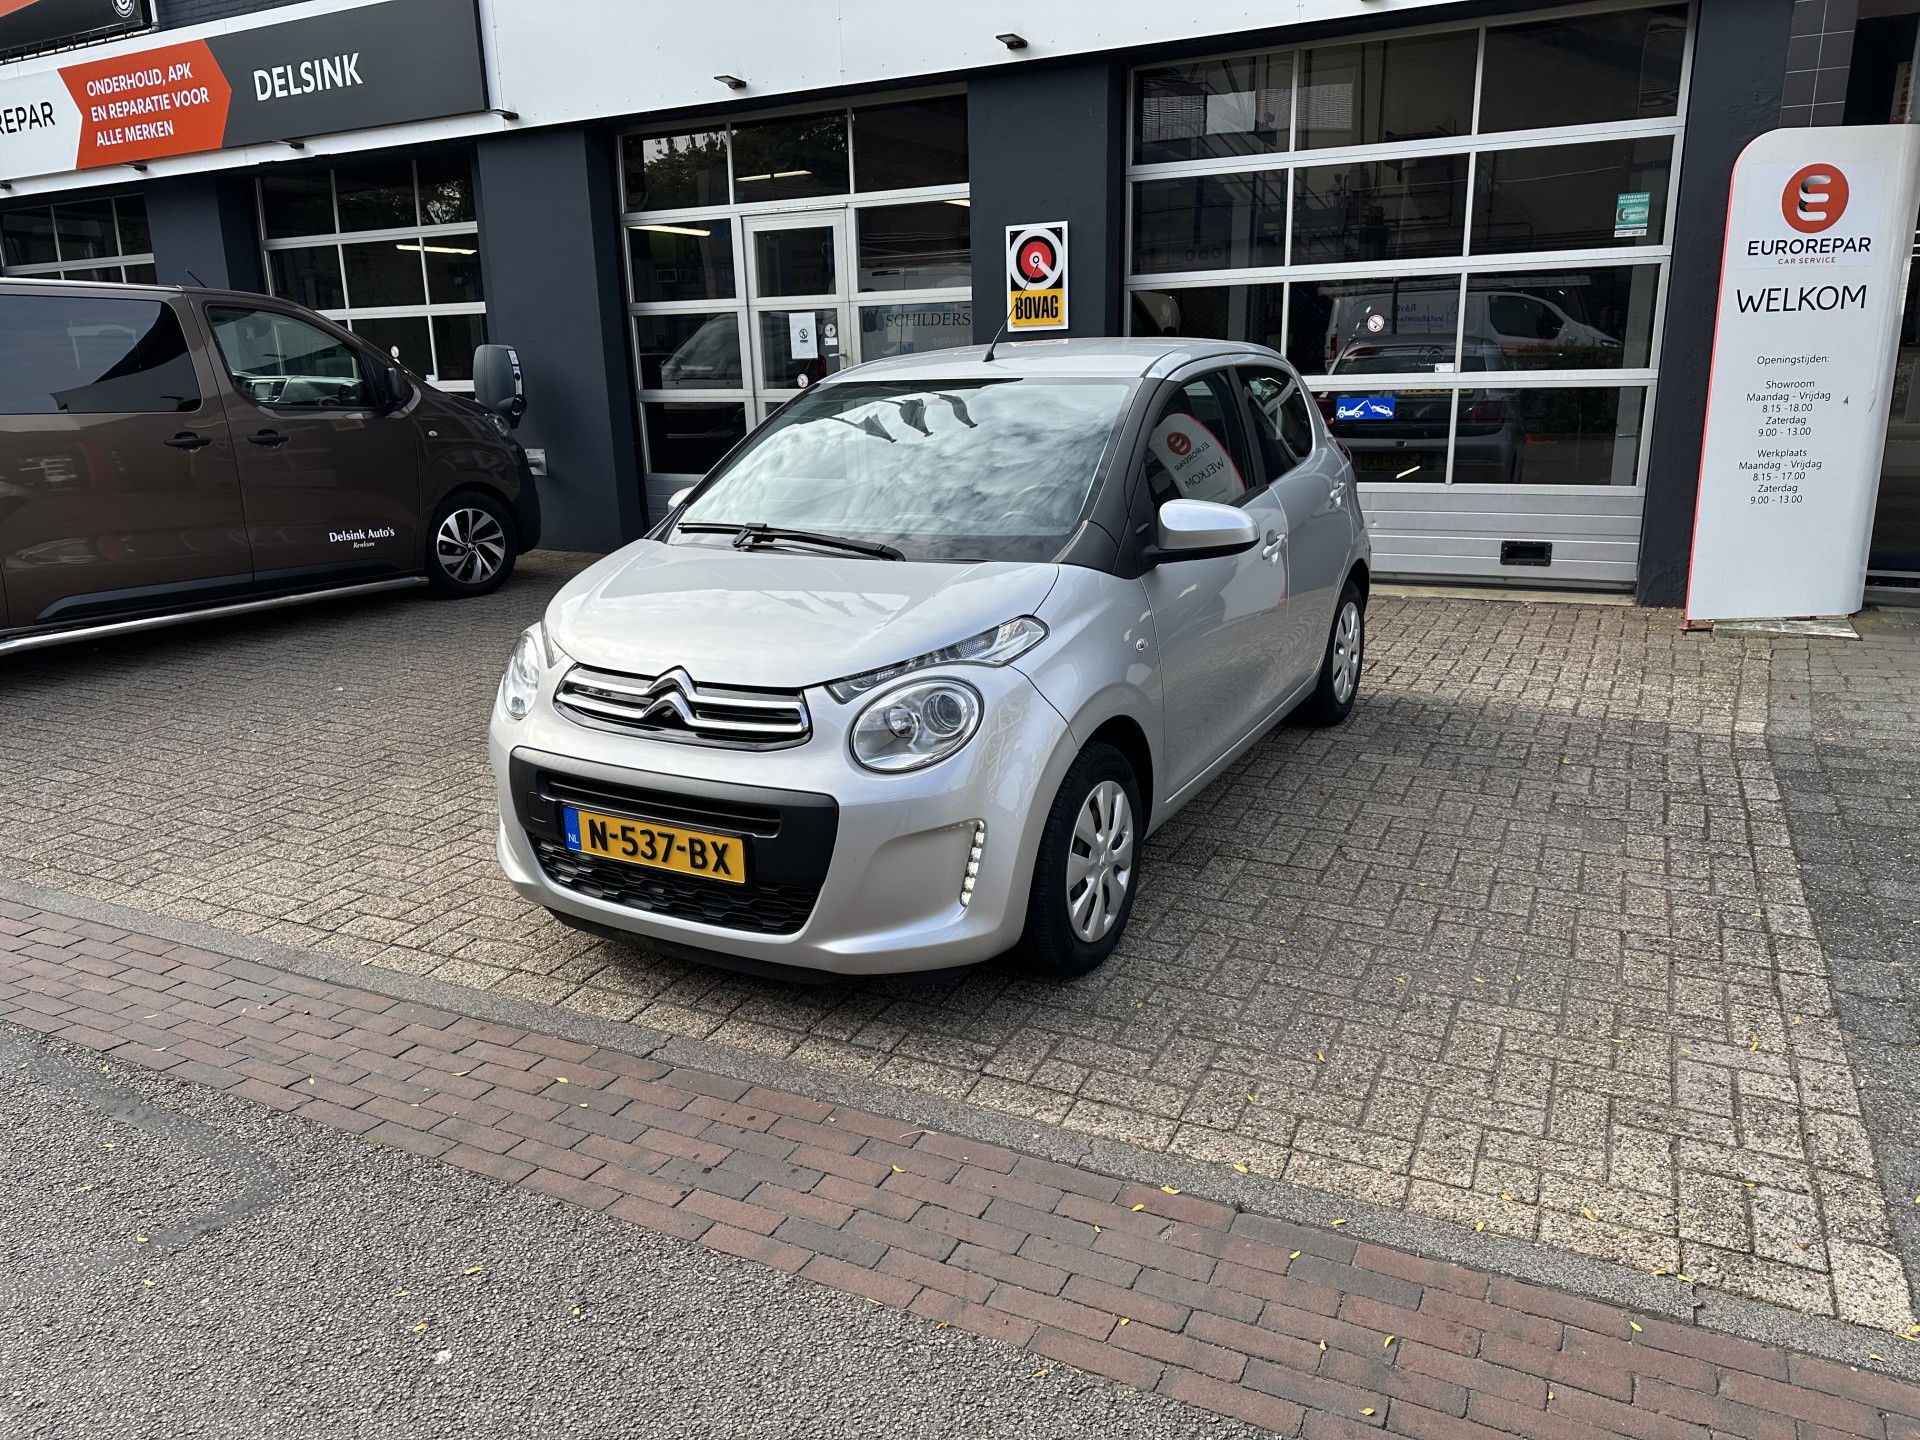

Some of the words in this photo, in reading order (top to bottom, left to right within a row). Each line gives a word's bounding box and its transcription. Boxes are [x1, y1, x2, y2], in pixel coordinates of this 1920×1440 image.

[86, 68, 166, 97] ONDERHOUD,
[168, 62, 193, 82] APK
[253, 53, 363, 100] DELSINK
[91, 105, 108, 122] EN
[108, 93, 172, 119] REPARATIE
[171, 86, 210, 108] VOOR
[97, 128, 123, 147] ALLE
[125, 120, 174, 143] MERKEN
[1747, 237, 1872, 256] EUROREPAR
[1798, 256, 1837, 264] SERVICE
[1736, 284, 1867, 314] WELKOM
[1015, 295, 1059, 320] BOVAG
[885, 312, 971, 328] SCHILDERS
[1756, 354, 1830, 367] Openingstijden:
[1765, 380, 1816, 390] Showroom
[1746, 392, 1790, 403] Maandag
[1799, 390, 1832, 402] Vrijdag
[1761, 404, 1781, 414] 8.15
[1765, 415, 1808, 426] Zaterdag
[1758, 428, 1778, 438] 9.00
[1787, 426, 1812, 437] 13.00
[1757, 448, 1808, 460] Werkplaats
[1738, 461, 1782, 472] Maandag
[1790, 459, 1823, 471] Vrijdag
[1752, 472, 1773, 482] 8.15
[1782, 471, 1806, 481] 17.00
[1757, 484, 1799, 494] Zaterdag
[1749, 496, 1769, 505] 9.00
[1779, 494, 1803, 504] 13.00
[329, 529, 366, 542] Delsink
[368, 526, 395, 538] Auto's
[568, 832, 580, 844] NL
[588, 818, 732, 876] N-537-BX
